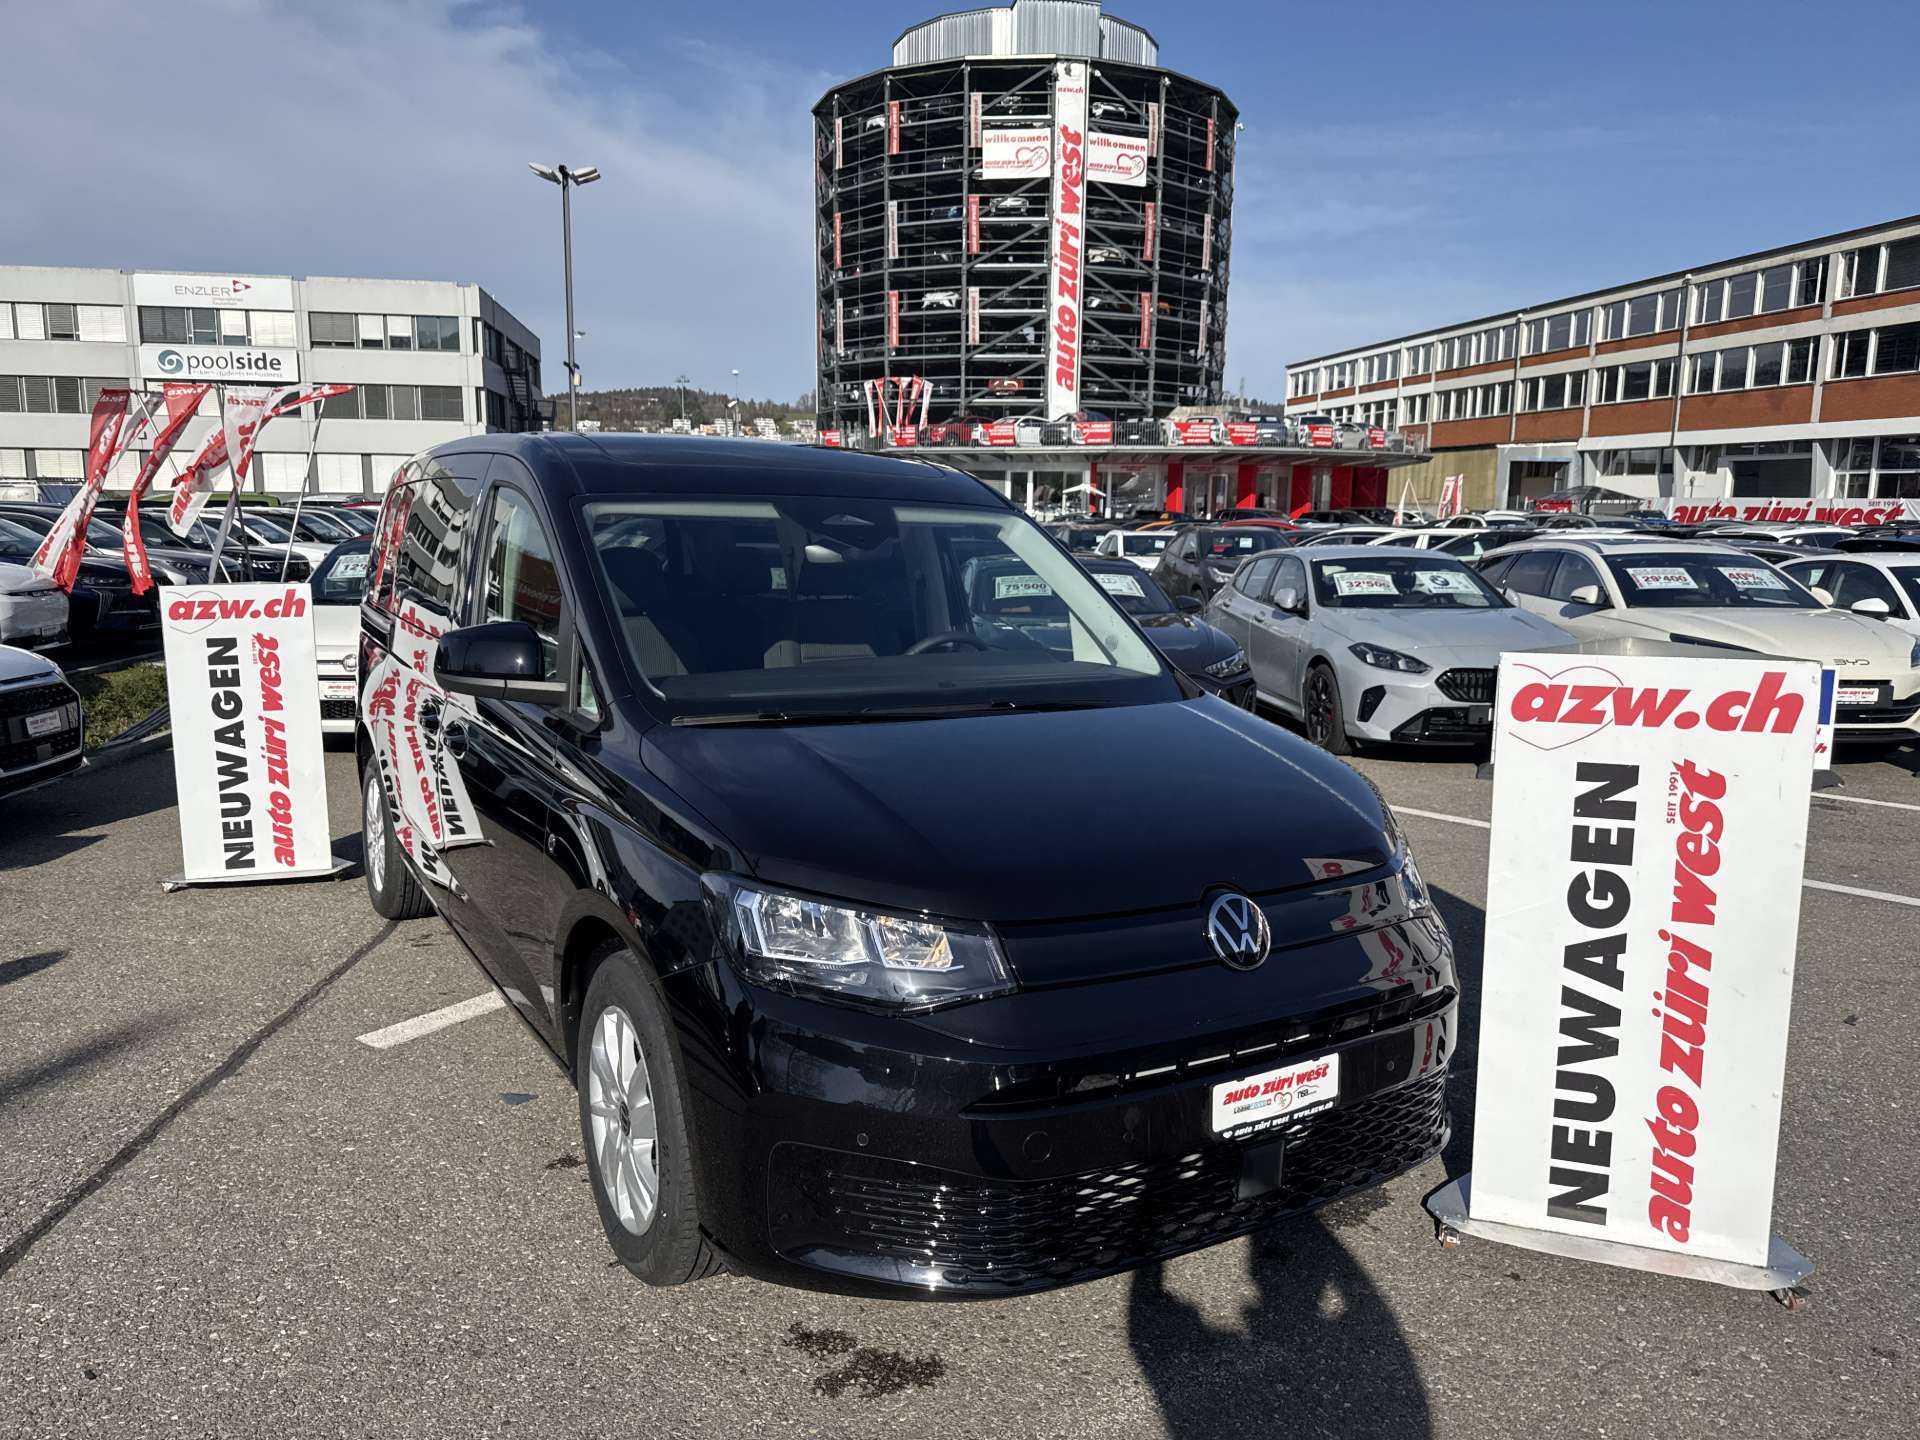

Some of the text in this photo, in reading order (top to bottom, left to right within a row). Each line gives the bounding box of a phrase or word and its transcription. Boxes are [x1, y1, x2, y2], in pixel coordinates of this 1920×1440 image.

[1057, 86, 1084, 94] azw.ch
[984, 134, 1049, 144] willkommen
[1089, 137, 1146, 152] willkommen
[1055, 125, 1082, 392] auto züri west
[174, 285, 232, 297] ENZLER
[187, 351, 282, 375] poolside
[1672, 498, 1905, 527] auto züri west
[1642, 575, 1687, 583] 29'400
[168, 589, 305, 621] azw.ch
[1833, 658, 1870, 666] BYD
[1511, 672, 1804, 734] azw.ch
[206, 637, 255, 870] NEUWAGEN
[252, 632, 296, 867] auto züri west
[1666, 771, 1679, 824] SEIT 1991
[1547, 761, 1640, 1226] NEUWAGEN
[1644, 759, 1727, 1244] auto züri west
[1223, 1063, 1330, 1106] auto züri west
[1234, 1125, 1253, 1137] auto
